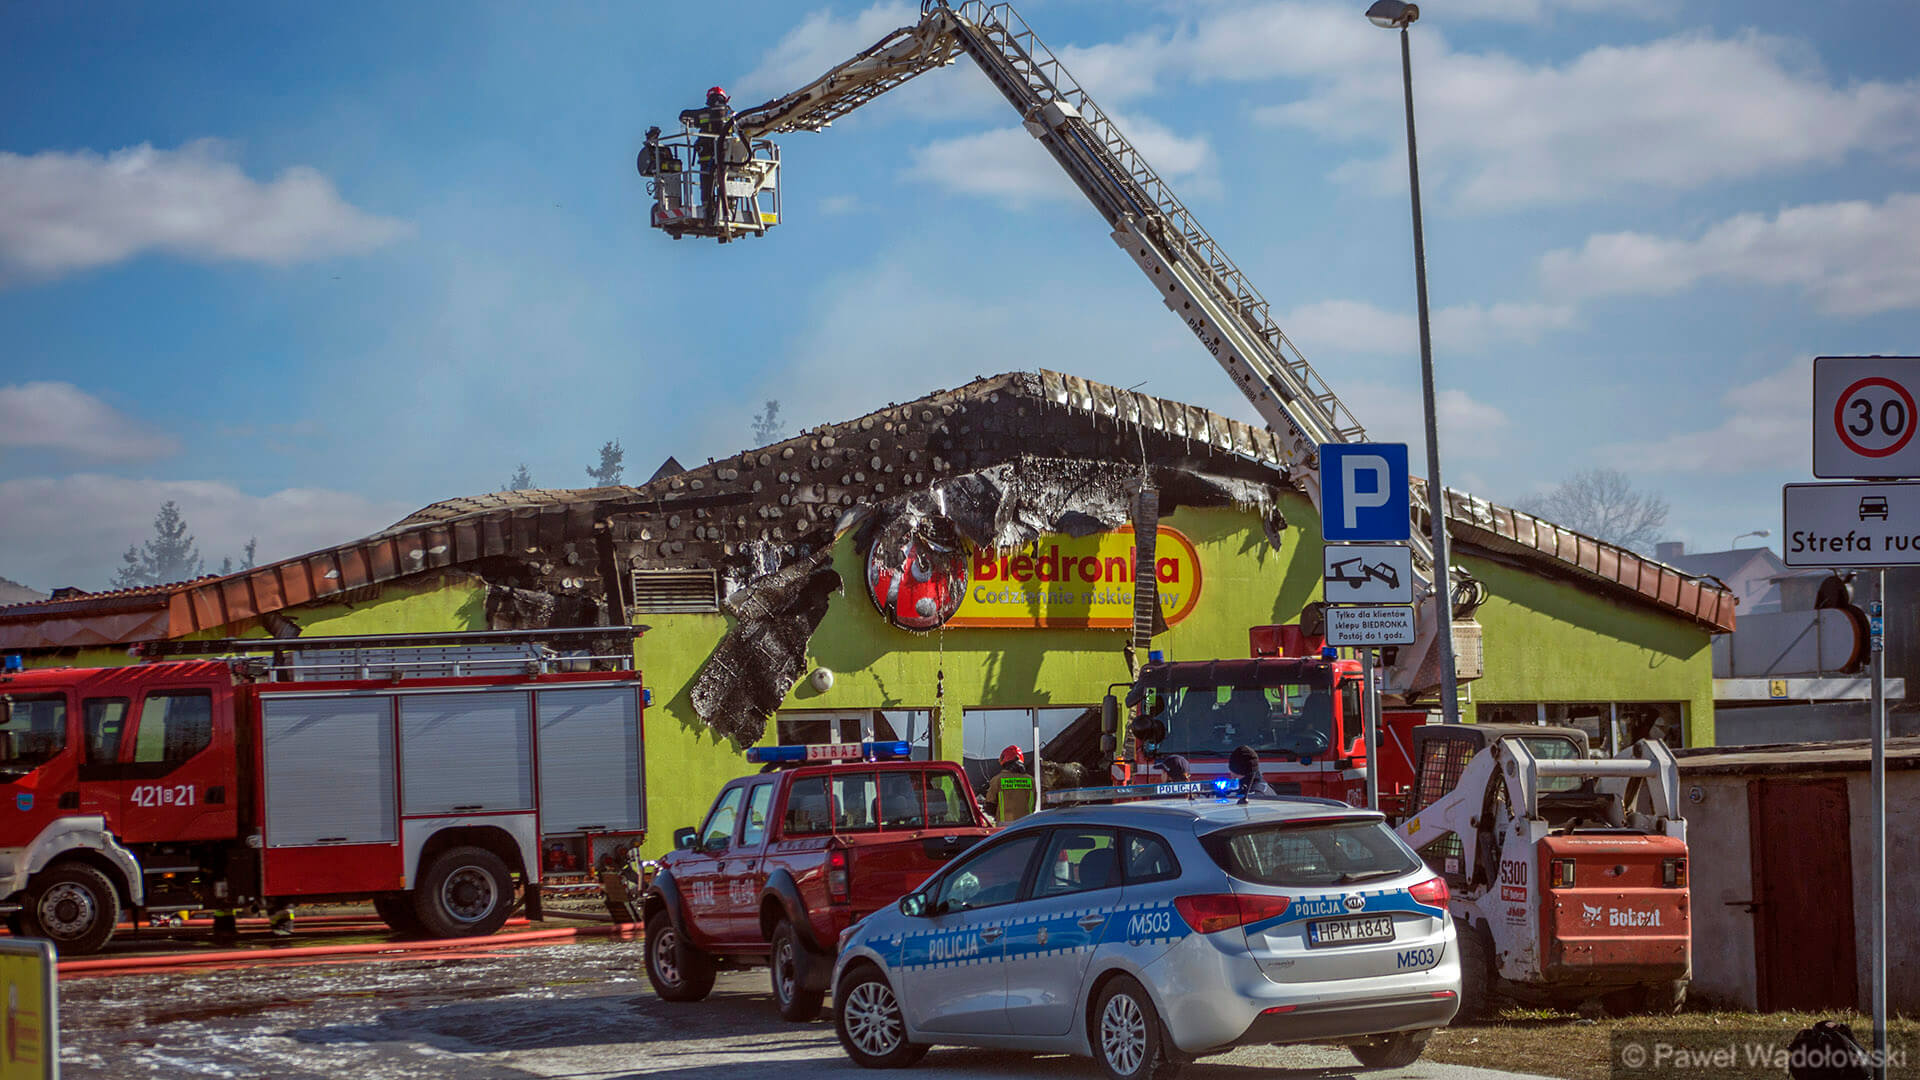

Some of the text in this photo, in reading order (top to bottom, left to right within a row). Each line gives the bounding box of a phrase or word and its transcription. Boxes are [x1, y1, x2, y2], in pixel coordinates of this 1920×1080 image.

[1848, 398, 1905, 437] 30
[1341, 454, 1390, 529] P
[1791, 530, 1871, 552] Strefa
[973, 586, 1075, 605] Codziennie
[1081, 586, 1132, 605] niskie
[1335, 620, 1408, 631] sklepu BIEDRONKA
[1336, 610, 1406, 620] Tylko dla klientów
[1338, 631, 1363, 640] Postój
[1365, 631, 1376, 640] do
[1383, 631, 1405, 641] godz.
[1159, 783, 1200, 795] POLICJA
[1500, 859, 1528, 886] S300
[1295, 901, 1341, 917] POLICJA
[1609, 907, 1660, 927] Bobcat
[1131, 911, 1170, 936] M503
[1319, 918, 1392, 941] HPM A843
[929, 933, 979, 961] POLICJA
[1397, 948, 1435, 969] M503
